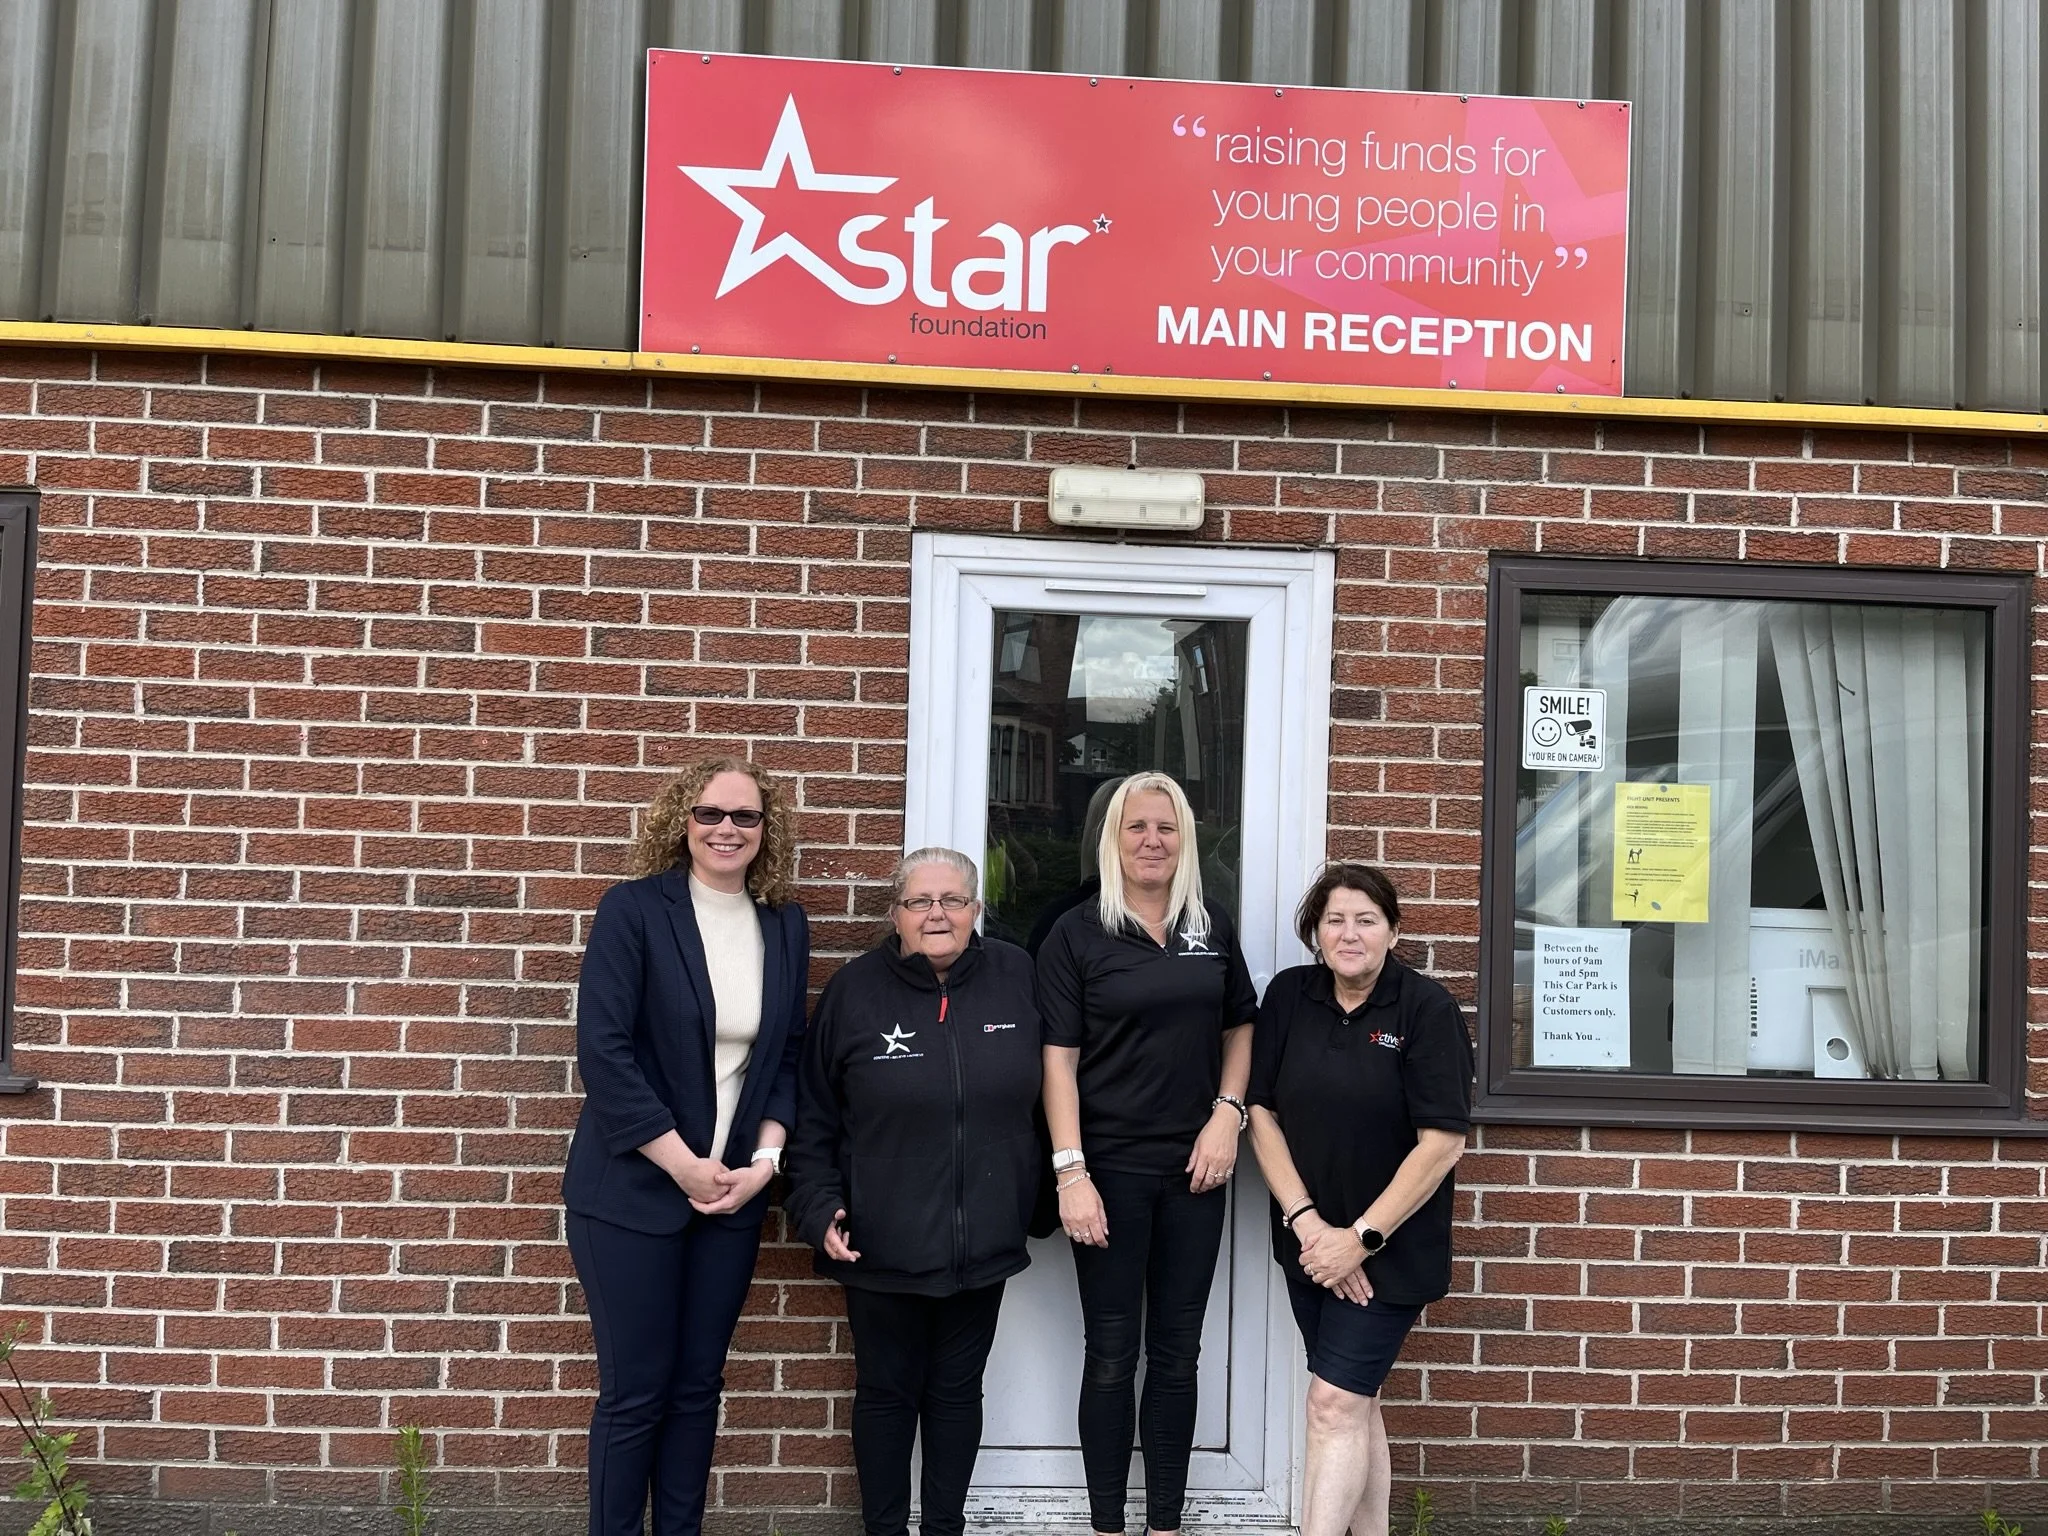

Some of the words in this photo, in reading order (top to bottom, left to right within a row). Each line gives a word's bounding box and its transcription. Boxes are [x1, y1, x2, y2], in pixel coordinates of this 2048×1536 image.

[1361, 131, 1477, 173] funds
[1491, 136, 1546, 177] for
[1212, 189, 1340, 233] young
[1356, 191, 1497, 237] people
[1513, 194, 1546, 233] in
[837, 195, 1092, 313] star
[1210, 243, 1302, 283] your
[909, 312, 1048, 340] foundation
[1157, 305, 1286, 349] MAIN
[1304, 311, 1593, 362] RECEPTION
[1540, 696, 1590, 715] SMILE!
[1557, 752, 1568, 762] ON
[1569, 753, 1597, 763] CAMERA
[1543, 943, 1582, 953] Between
[1584, 944, 1599, 953] the
[1543, 956, 1569, 965] hours
[1571, 956, 1582, 965] of
[1583, 956, 1603, 966] 9am
[1799, 949, 1840, 970] iMa
[1559, 969, 1576, 978] and
[1578, 969, 1599, 980] 5pm
[1543, 981, 1563, 990] This
[1565, 981, 1584, 990] Car
[1586, 982, 1608, 991] Park
[1610, 982, 1618, 991] is
[1543, 993, 1557, 1003] for
[1559, 993, 1581, 1003] Star
[1542, 1006, 1592, 1016] Customers
[1594, 1007, 1616, 1018] only.
[1543, 1031, 1573, 1041] Thank
[1575, 1031, 1593, 1041] You
